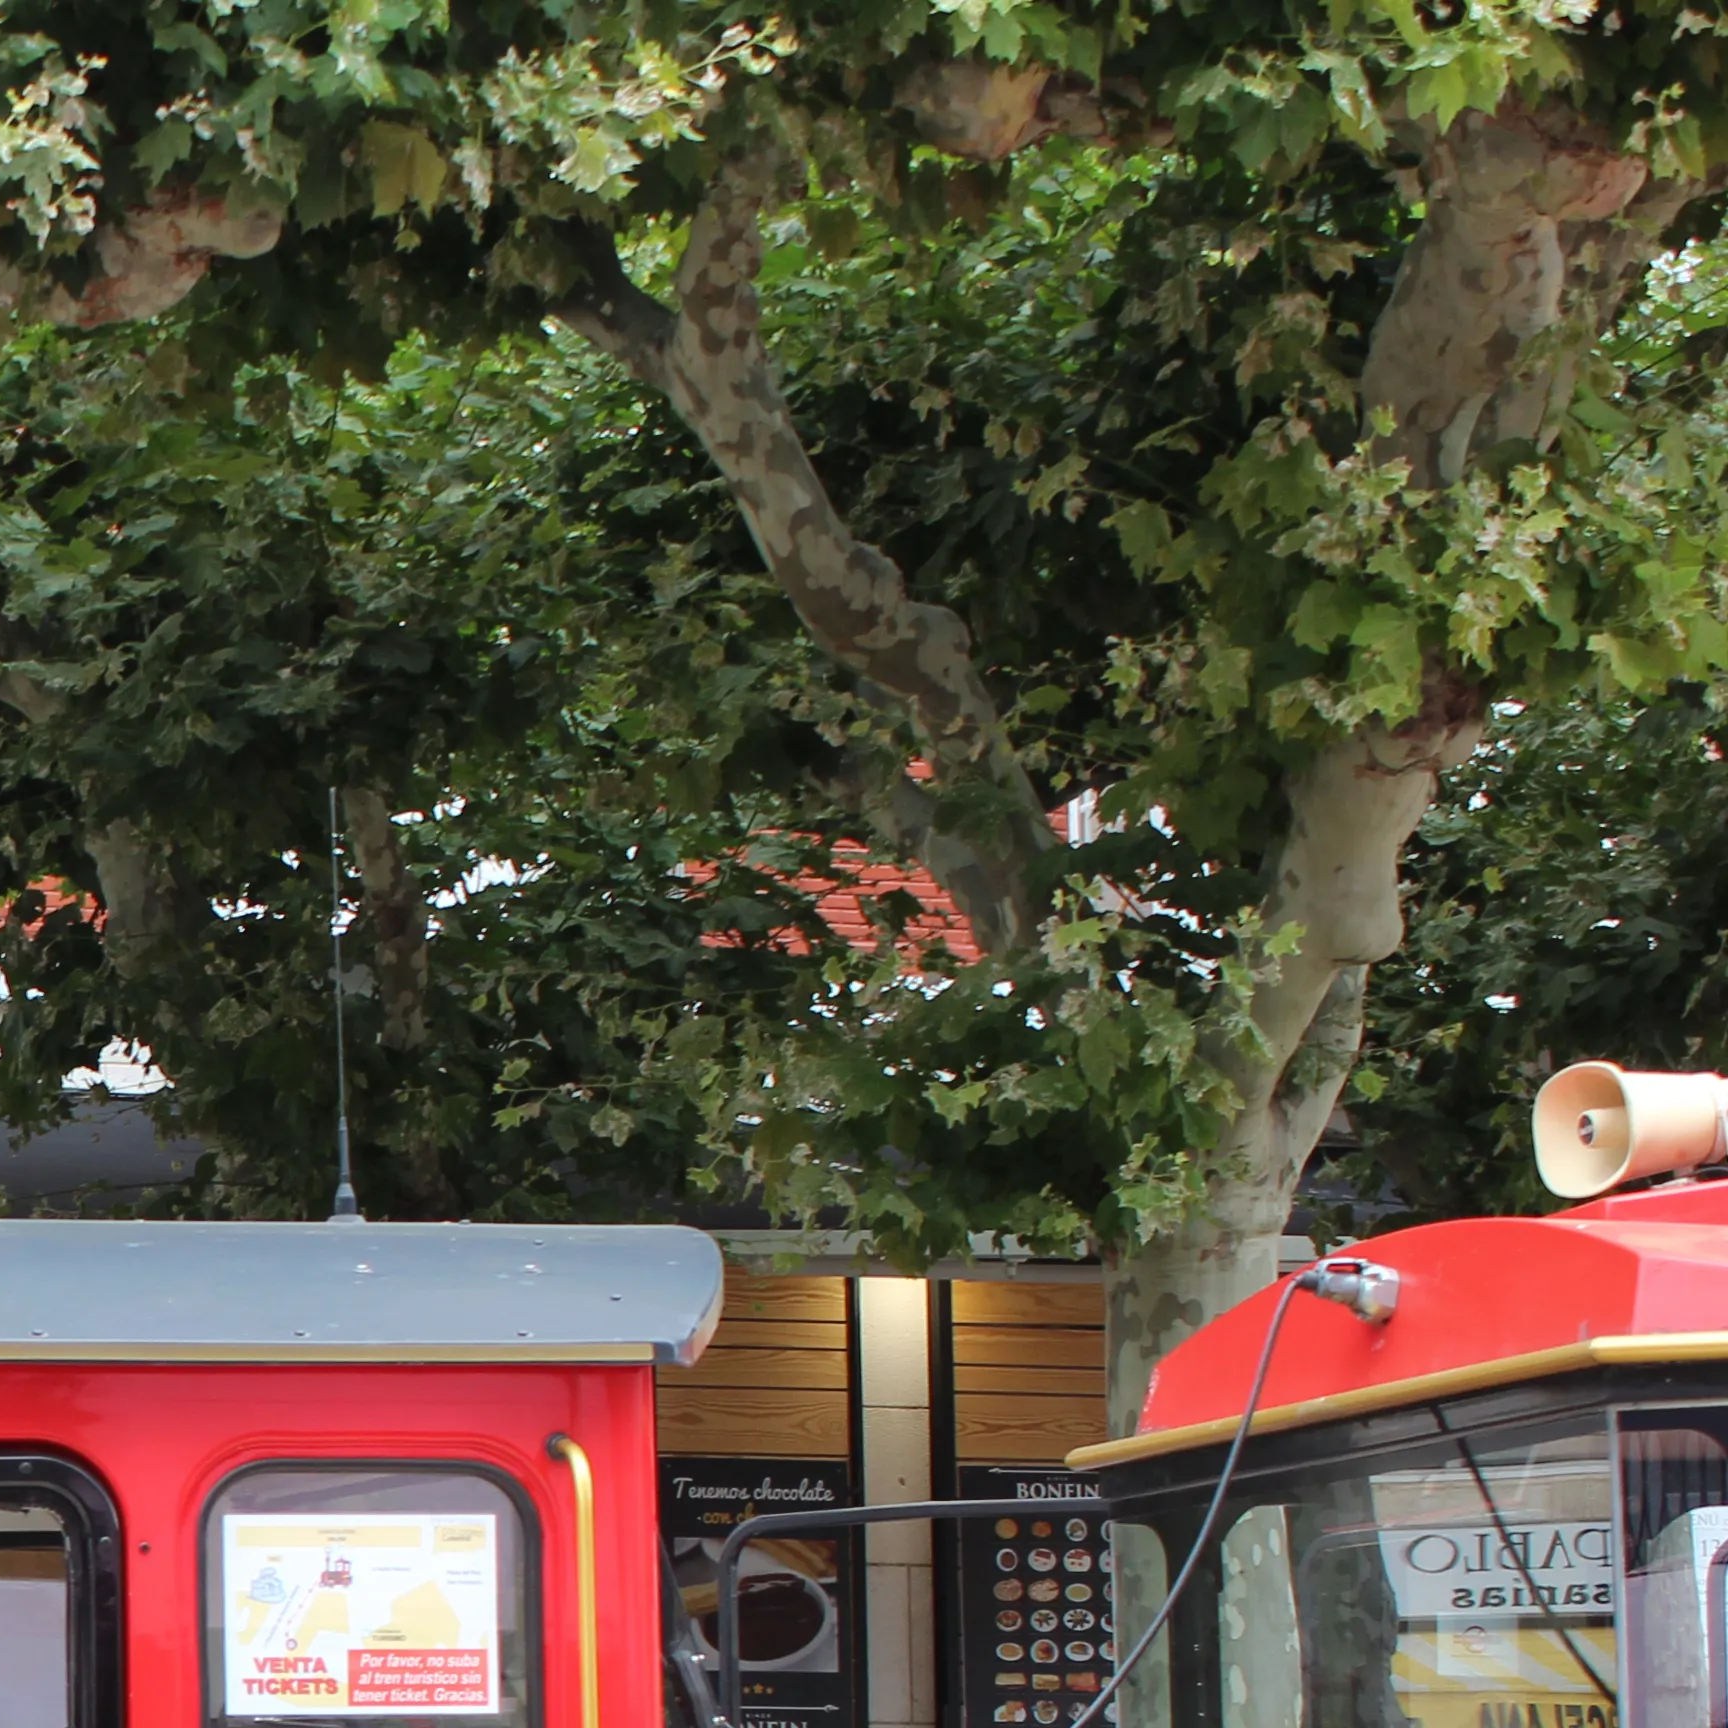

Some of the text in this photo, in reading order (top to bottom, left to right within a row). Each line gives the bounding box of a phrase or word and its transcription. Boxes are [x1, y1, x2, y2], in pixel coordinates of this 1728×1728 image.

[672, 1477, 835, 1501] Tenemos chocolate
[1016, 1482, 1101, 1499] BONFIN
[253, 1657, 328, 1674] VENTA
[359, 1653, 481, 1670] Por favor, no suba
[242, 1678, 339, 1695] TICKETS
[358, 1671, 372, 1685] al
[374, 1672, 402, 1685] tren
[460, 1671, 482, 1685] sin
[352, 1687, 488, 1703] tener ticket. Gracias.
